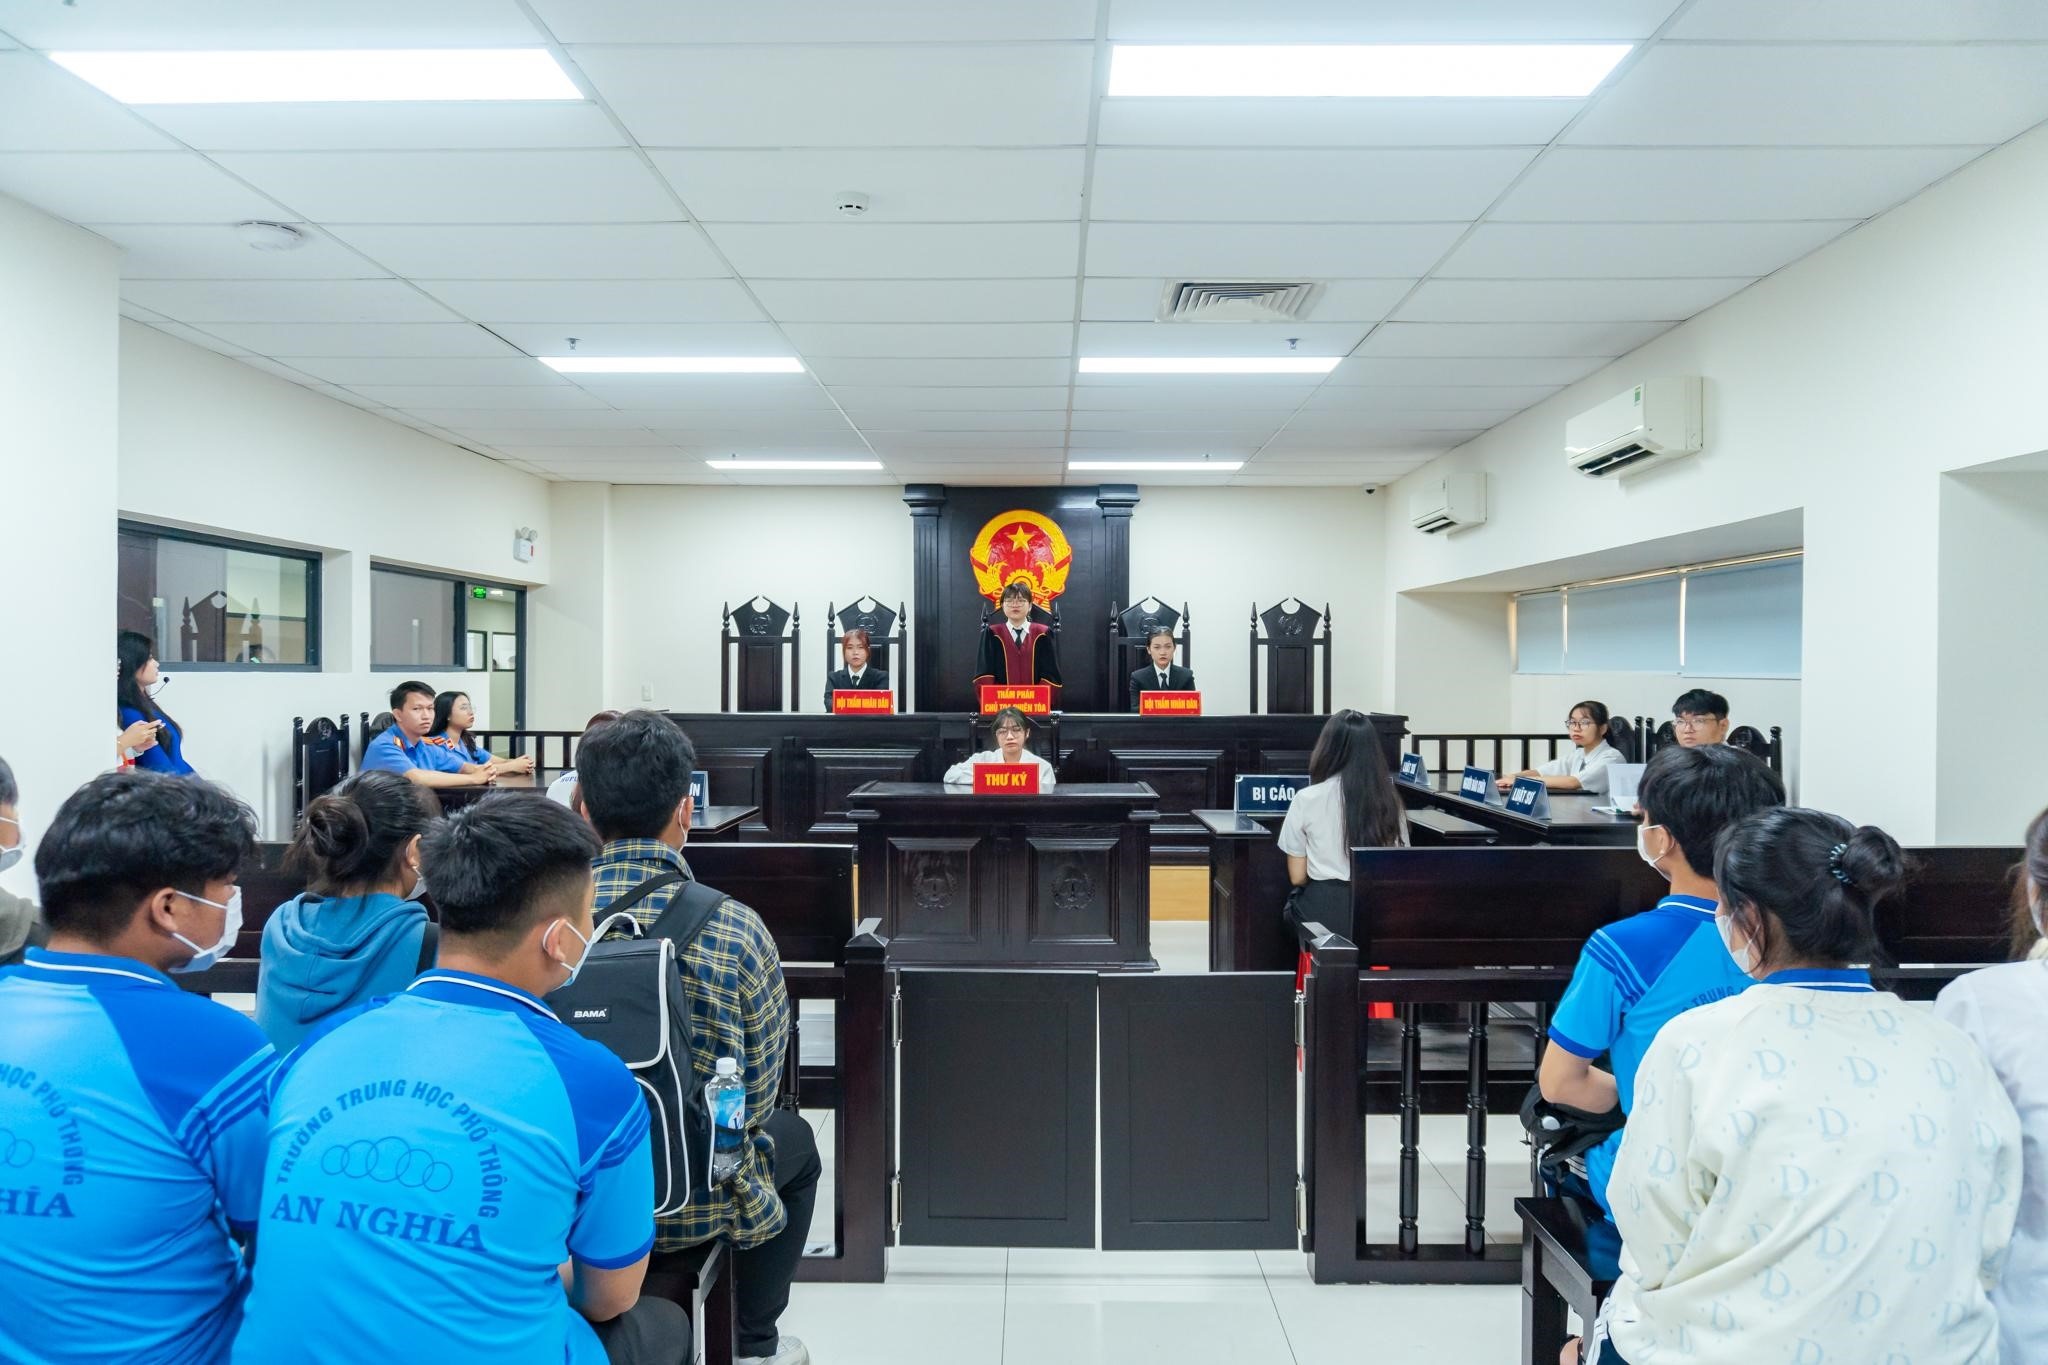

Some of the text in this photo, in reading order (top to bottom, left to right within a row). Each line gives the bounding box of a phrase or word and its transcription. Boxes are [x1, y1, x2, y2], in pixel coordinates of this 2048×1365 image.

[985, 771, 1027, 786] THƯ KÝ
[1252, 784, 1296, 804] BỊ CÁO
[1512, 786, 1536, 806] LUẬT SƯ
[276, 1079, 508, 1219] TRƯỜNG TRUNG HỌC PHỔ THÔNG
[0, 1185, 76, 1218] HĨA
[270, 1193, 488, 1252] AN NGHĨA
